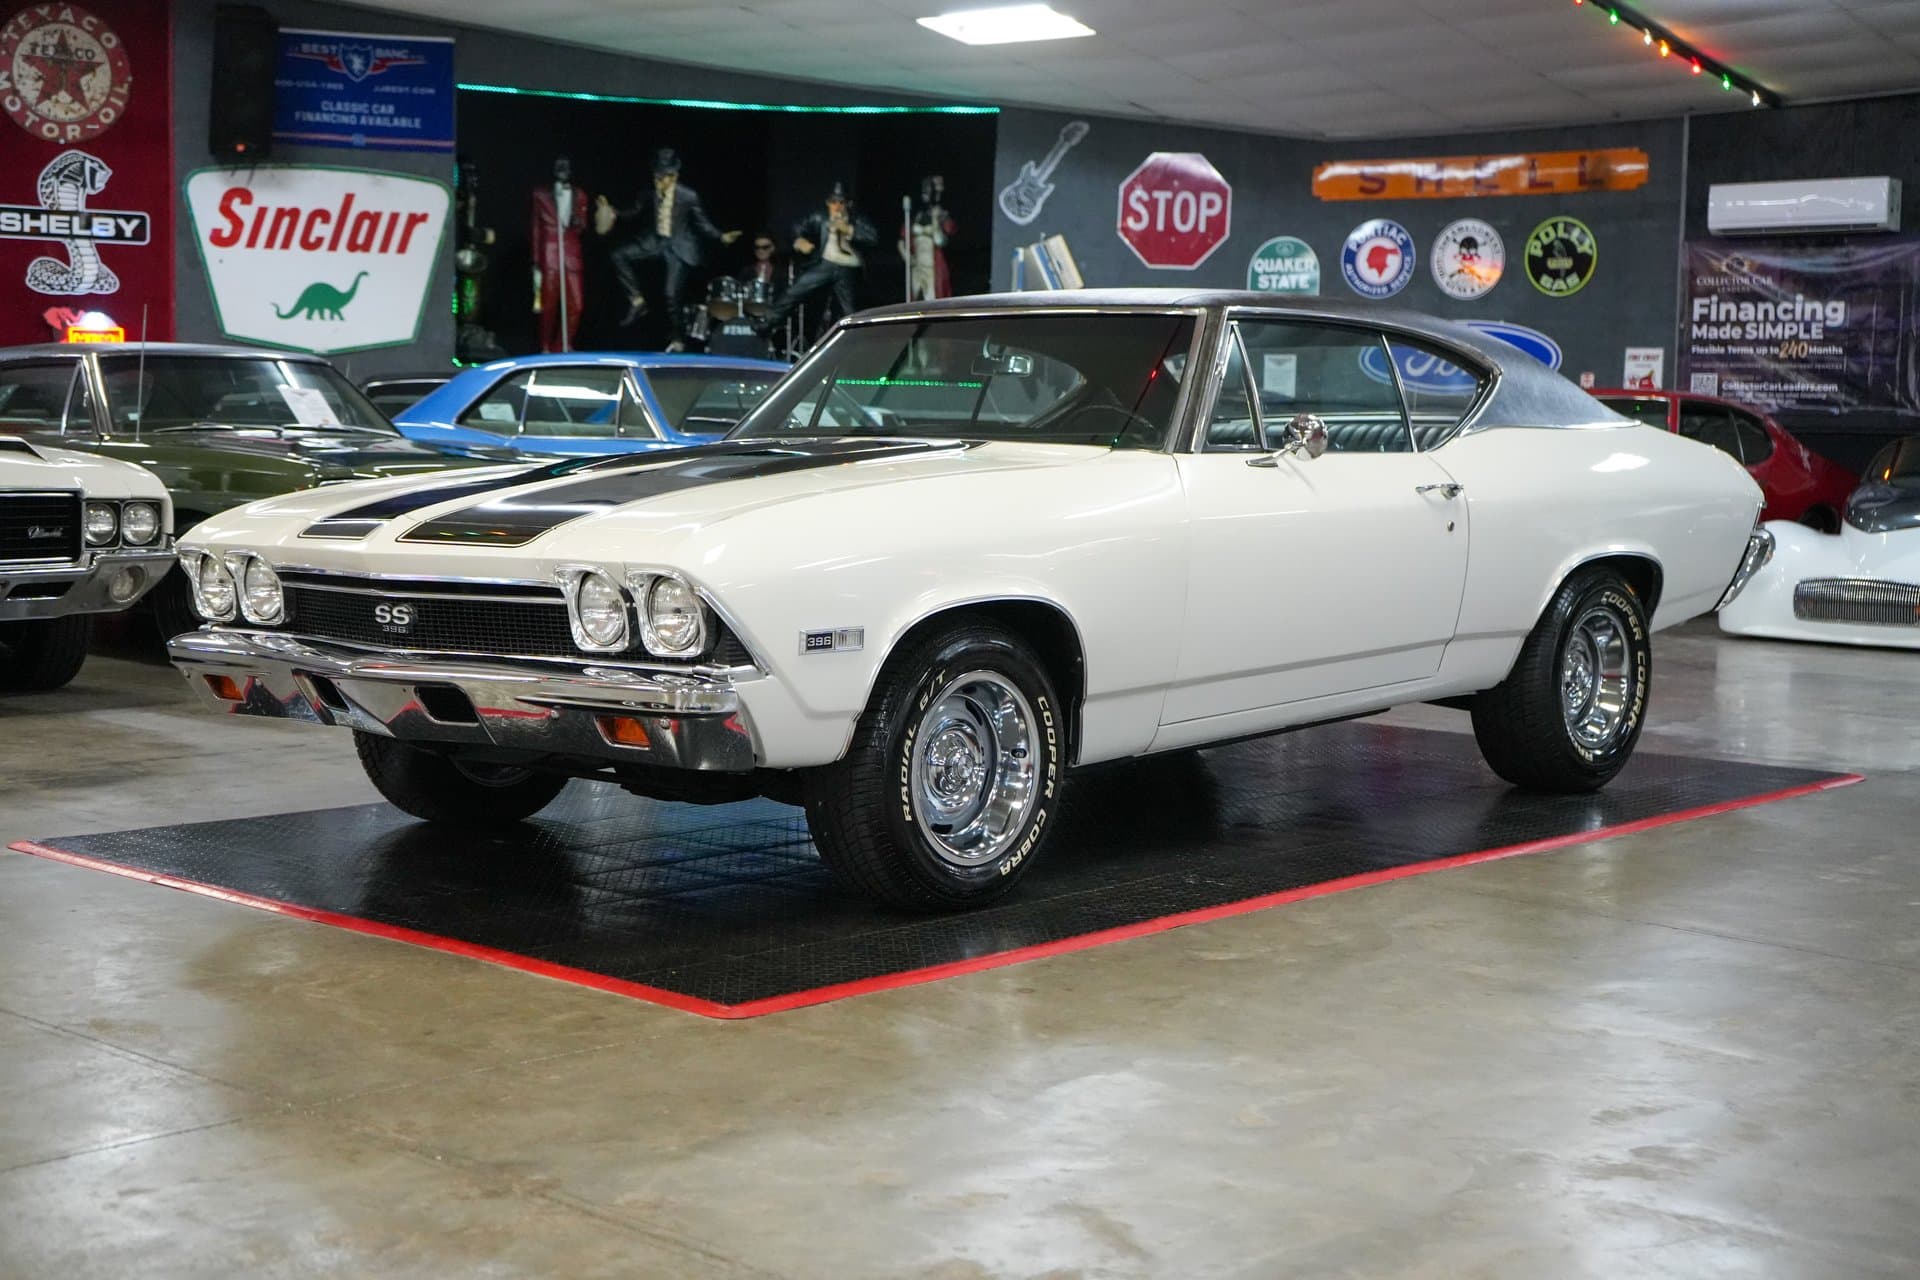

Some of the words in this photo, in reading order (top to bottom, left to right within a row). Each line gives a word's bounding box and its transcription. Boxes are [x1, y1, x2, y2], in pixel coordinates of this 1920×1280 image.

[2, 6, 118, 49] TEXACO
[295, 111, 356, 125] FINANCING
[359, 115, 422, 129] AVAILABLE
[320, 101, 369, 114] CLASSIC
[371, 103, 395, 115] CAR
[1359, 154, 1605, 195] SHELL
[209, 187, 429, 254] Sinclair
[1126, 185, 1223, 233] STOP
[0, 212, 140, 238] SHELBY
[1530, 222, 1593, 257] POLLY
[1254, 257, 1316, 273] QUAKER
[1258, 274, 1310, 289] STATE
[1692, 294, 1845, 328] Financing
[1692, 323, 1742, 339] Made
[1745, 322, 1824, 340] SIMPLE
[1692, 344, 1725, 355] Flexible
[1728, 345, 1754, 355] Terms
[1756, 346, 1768, 357] up
[1769, 345, 1779, 355] to
[1779, 341, 1808, 359] 240
[1809, 345, 1843, 355] Months
[1722, 381, 1838, 392] CollectorCarLeaders.com
[375, 605, 410, 625] SS
[382, 625, 406, 634] 396
[807, 636, 832, 647] 396
[1601, 591, 1643, 641] COOPER
[1627, 651, 1646, 729] COBRA
[900, 724, 917, 822] RADIAL
[919, 668, 947, 712] G/T
[1037, 696, 1058, 799] COOPER
[999, 808, 1047, 876] COBRA
